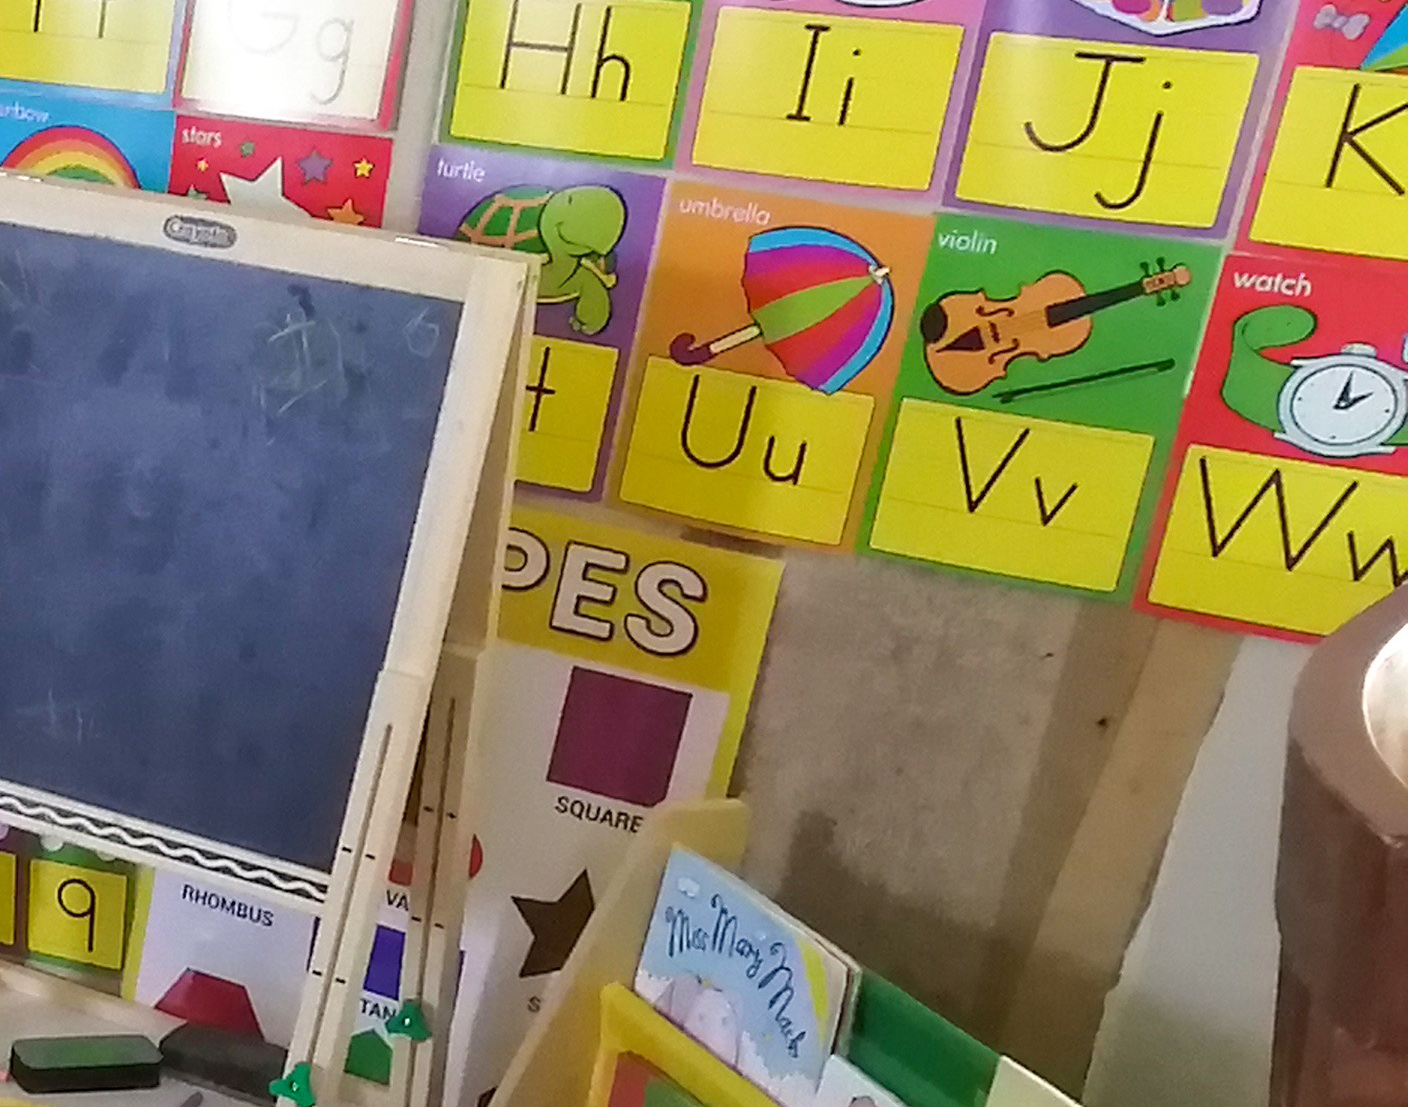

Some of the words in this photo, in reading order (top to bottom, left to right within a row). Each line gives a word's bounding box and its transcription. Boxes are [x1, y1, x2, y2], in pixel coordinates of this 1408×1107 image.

[500, 0, 631, 102] Hh
[785, 24, 872, 126] Ii
[182, 127, 223, 147] stars
[436, 158, 485, 183] turtle
[1024, 51, 1174, 210] Jj
[679, 198, 771, 226] umbrella
[937, 229, 998, 255] violin
[1233, 269, 1313, 297] watch
[681, 374, 807, 486] Uu
[956, 416, 1077, 527] Vv
[1199, 456, 1408, 588] Ww
[502, 526, 709, 657] PES
[554, 795, 645, 834] SQUARE
[57, 878, 97, 953] 9
[181, 883, 275, 928] RHOMBUS
[665, 904, 710, 958] Miss
[710, 893, 764, 979] Mary
